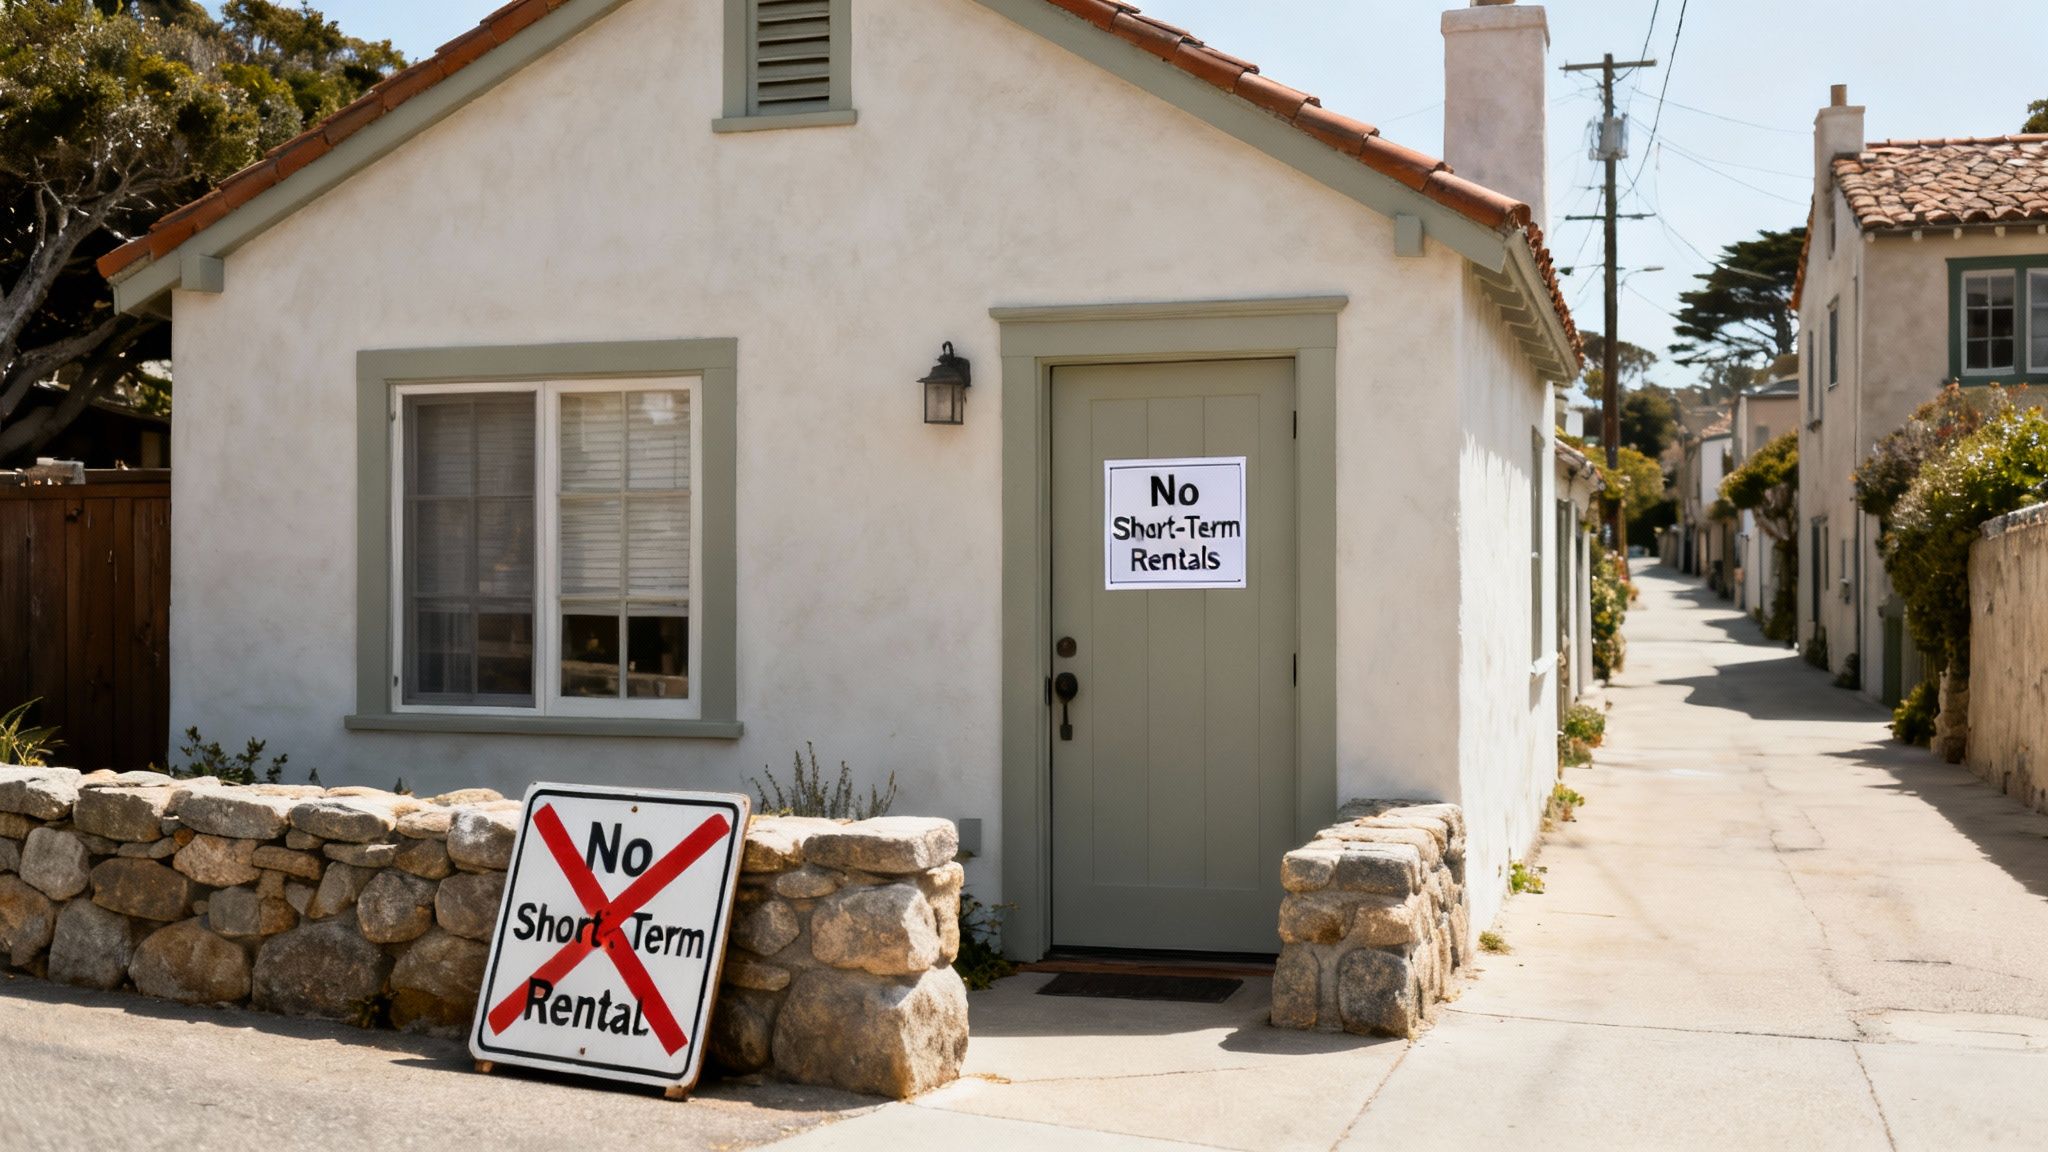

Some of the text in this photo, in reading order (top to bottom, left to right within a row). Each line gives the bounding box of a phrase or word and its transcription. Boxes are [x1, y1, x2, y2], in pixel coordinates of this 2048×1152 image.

[1150, 474, 1199, 506] No
[1131, 545, 1221, 572] Rentals
[586, 821, 653, 877] No
[524, 976, 649, 1036] Rental
